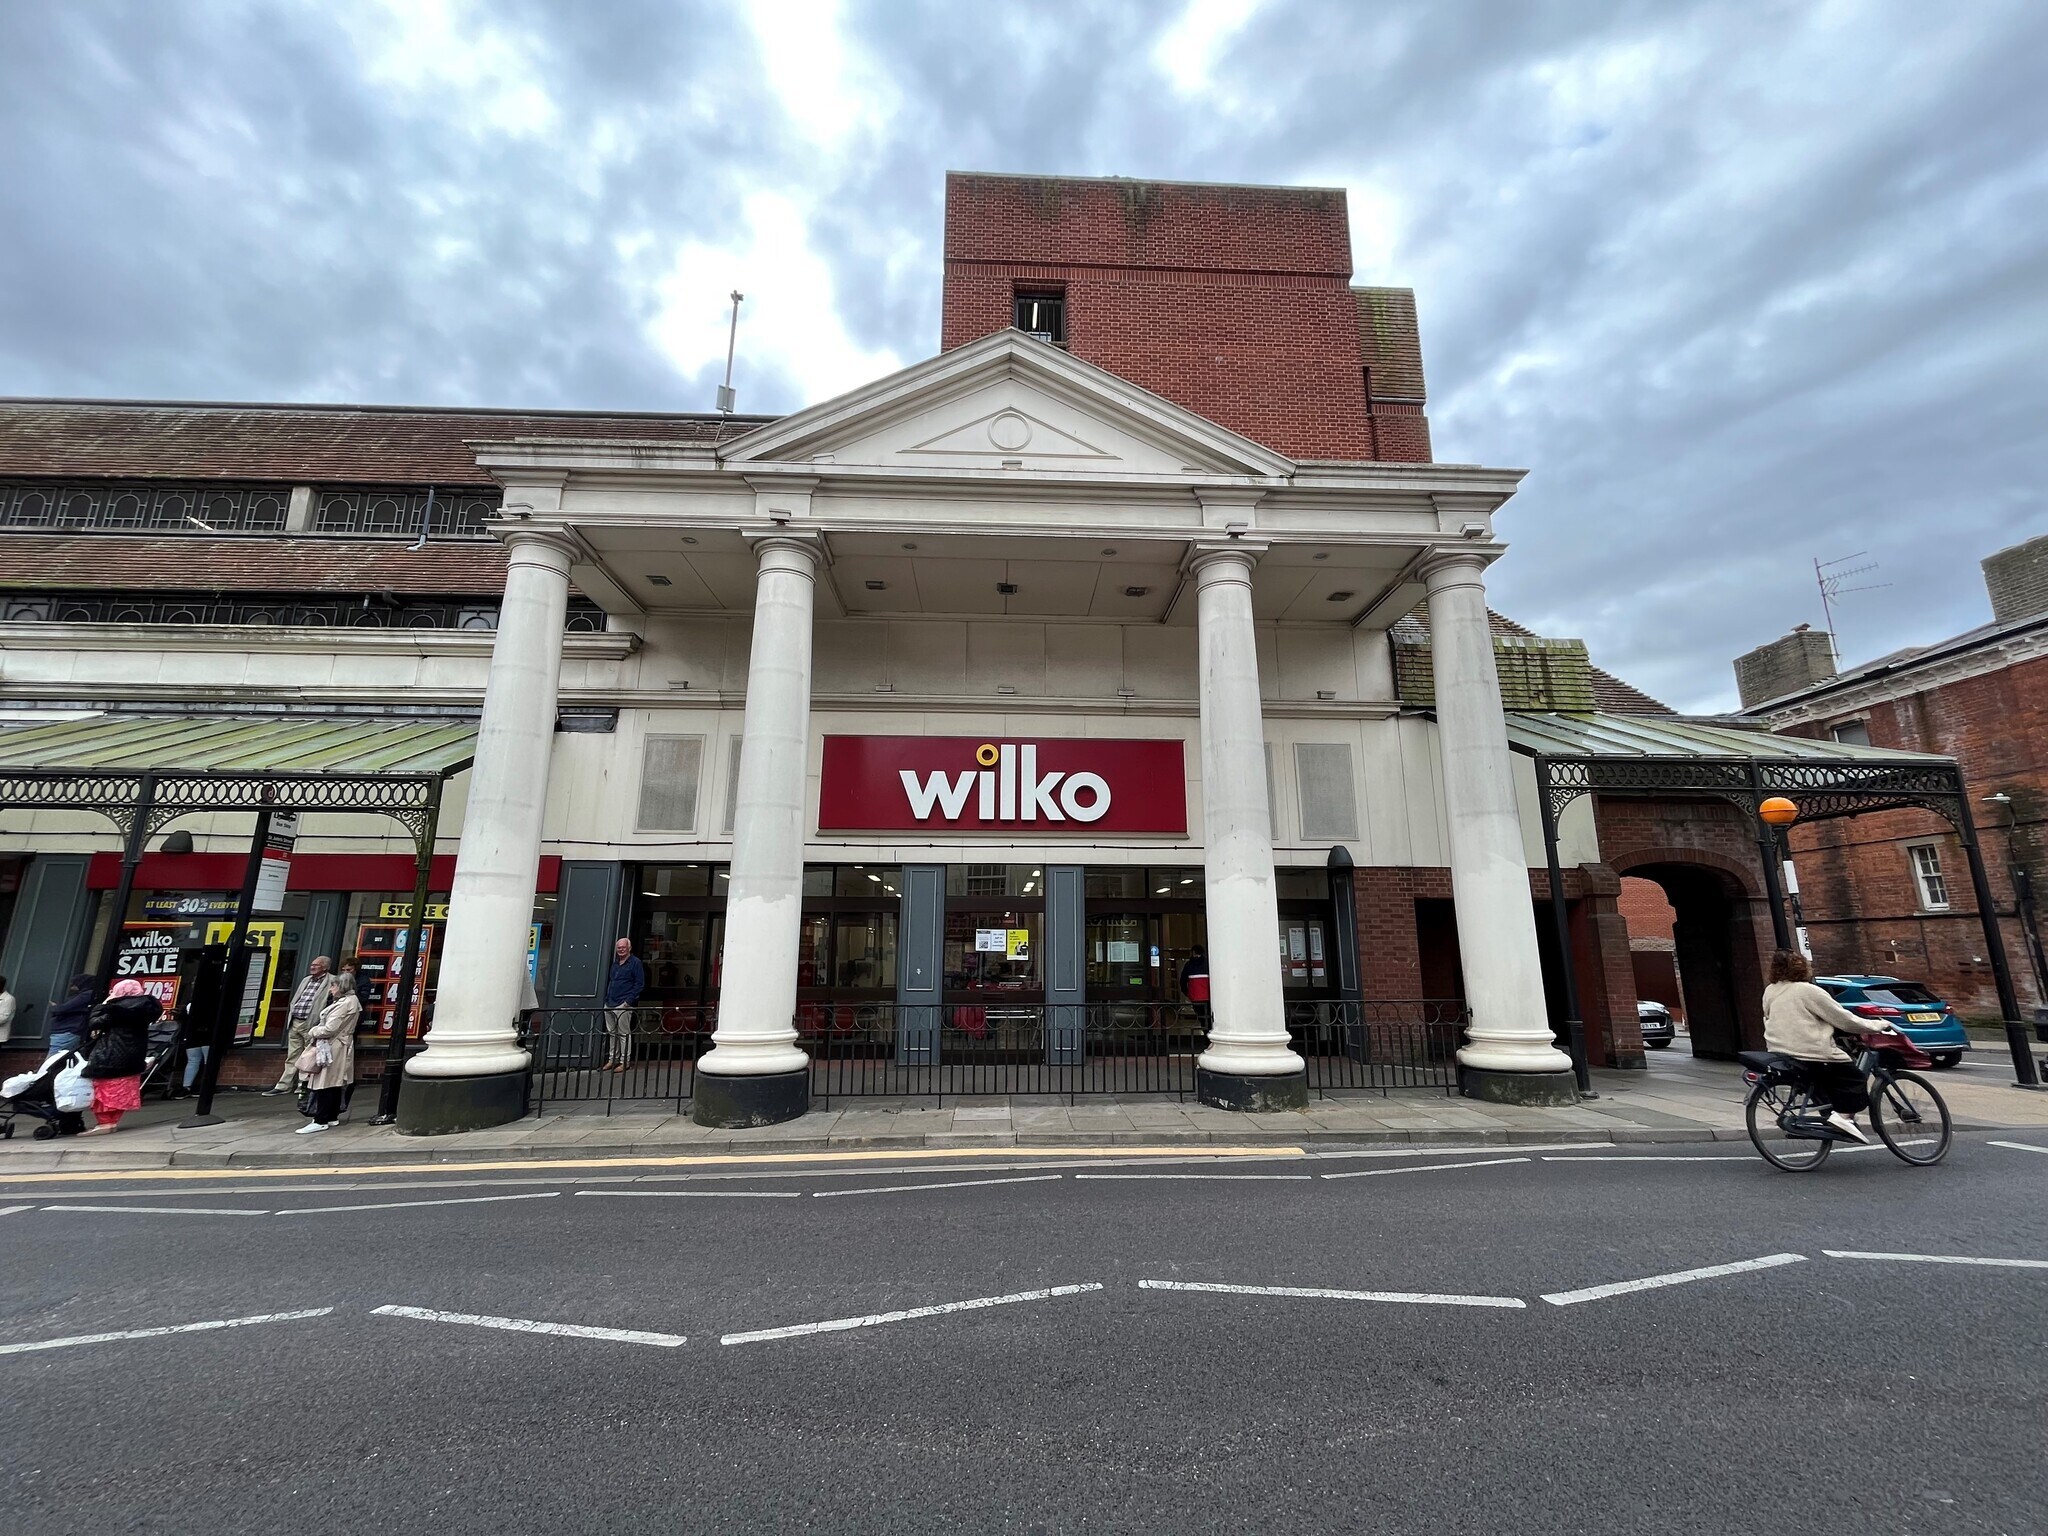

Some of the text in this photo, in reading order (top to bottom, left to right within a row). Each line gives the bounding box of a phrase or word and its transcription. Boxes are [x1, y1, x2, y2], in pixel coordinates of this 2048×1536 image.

[898, 743, 1111, 822] wilko
[178, 898, 208, 912] 30%
[130, 930, 173, 947] wilko
[211, 930, 276, 947] LST
[119, 947, 180, 955] ADMINISTRATION
[116, 954, 178, 975] SALE
[144, 982, 174, 1000] 70%
